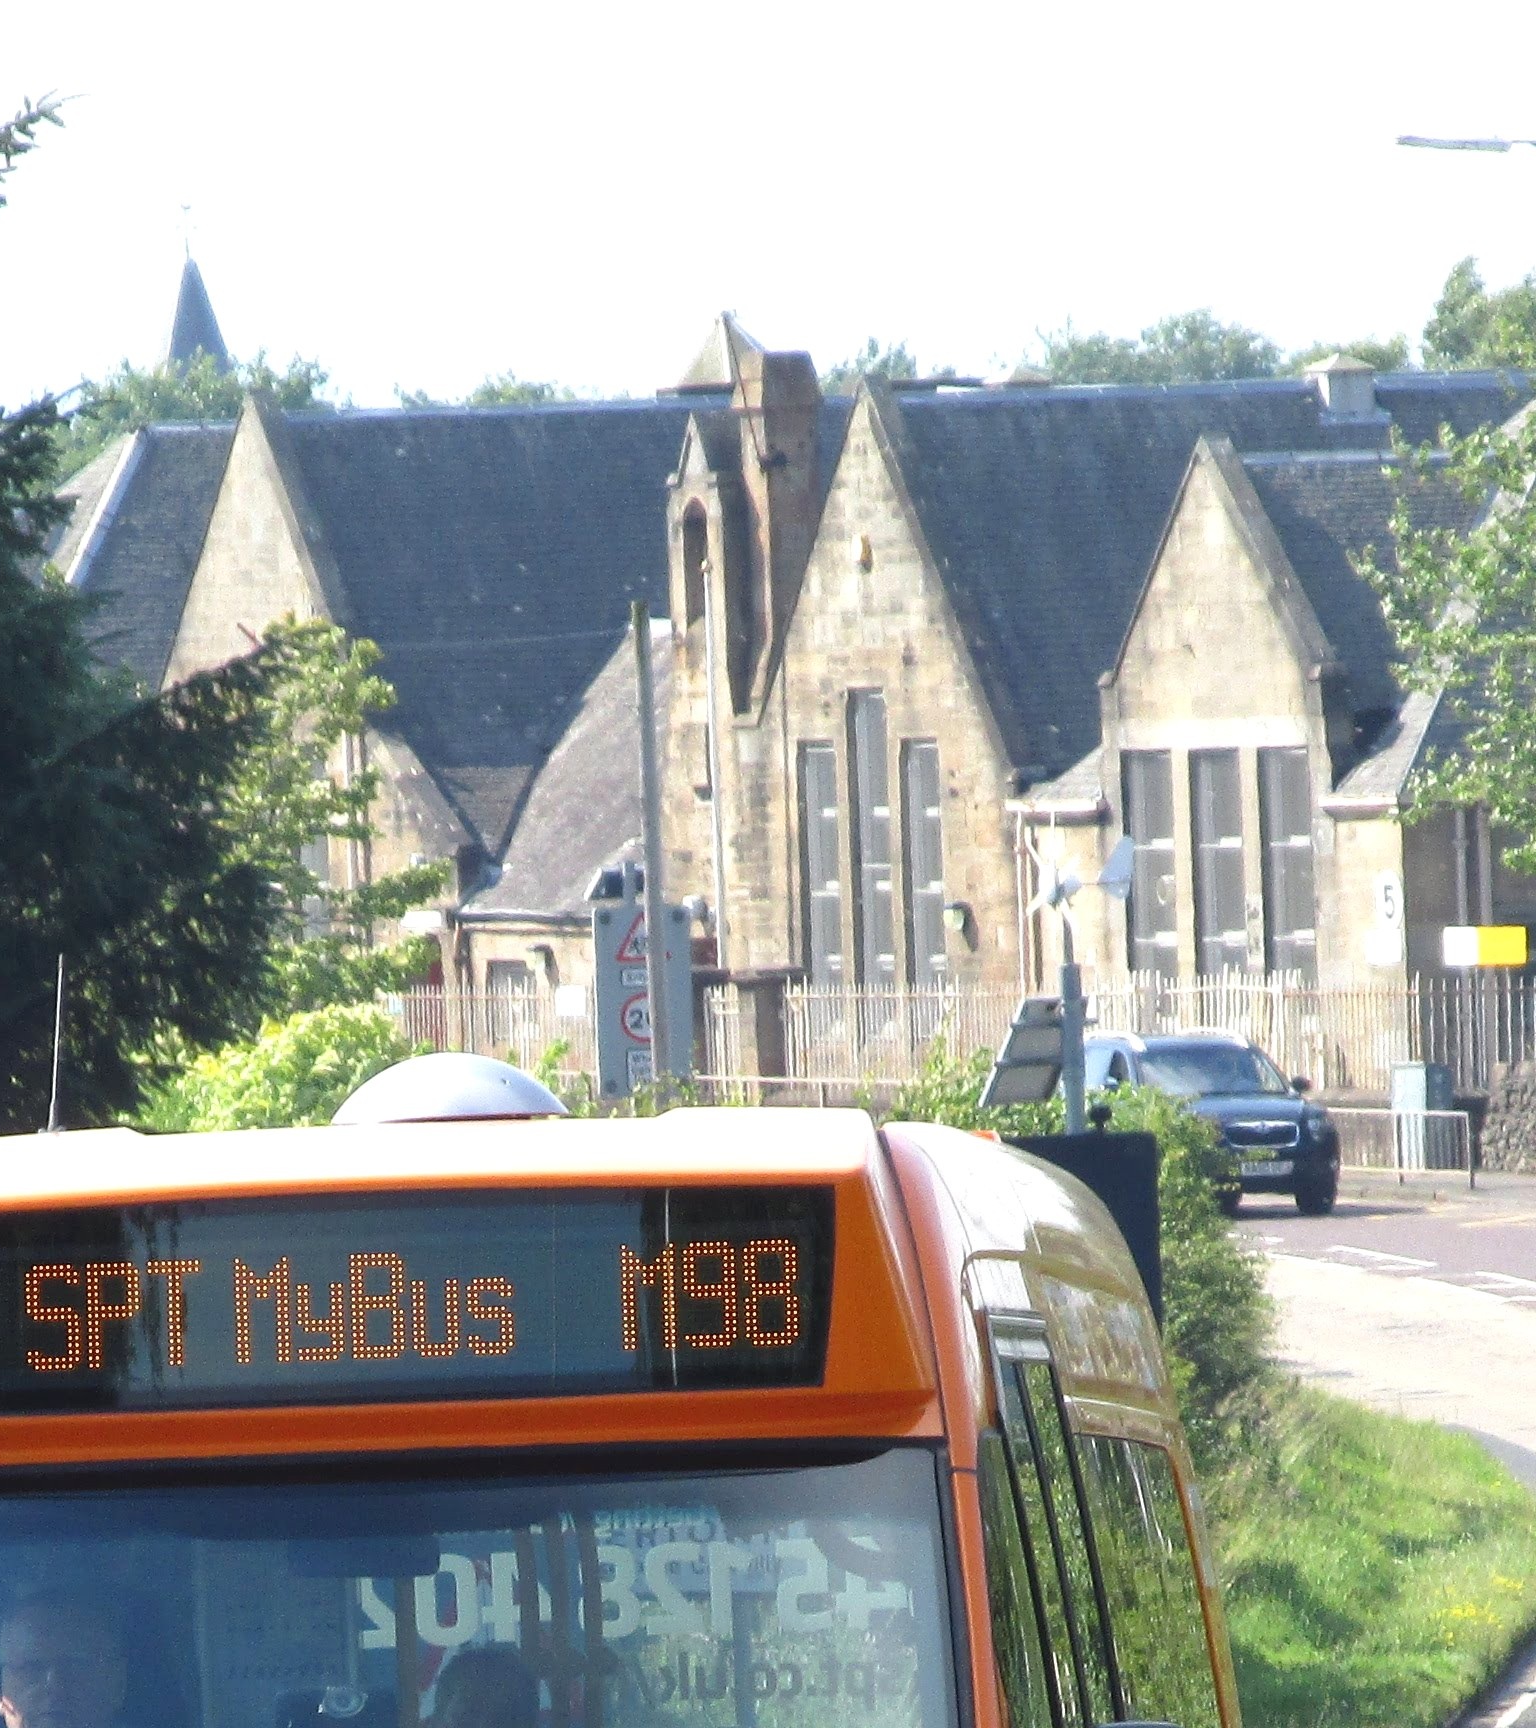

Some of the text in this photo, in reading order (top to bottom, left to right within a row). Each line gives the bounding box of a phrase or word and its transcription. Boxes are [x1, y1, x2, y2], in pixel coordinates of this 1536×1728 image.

[1384, 885, 1395, 919] 5
[24, 1237, 800, 1371] SPT MyBus M98
